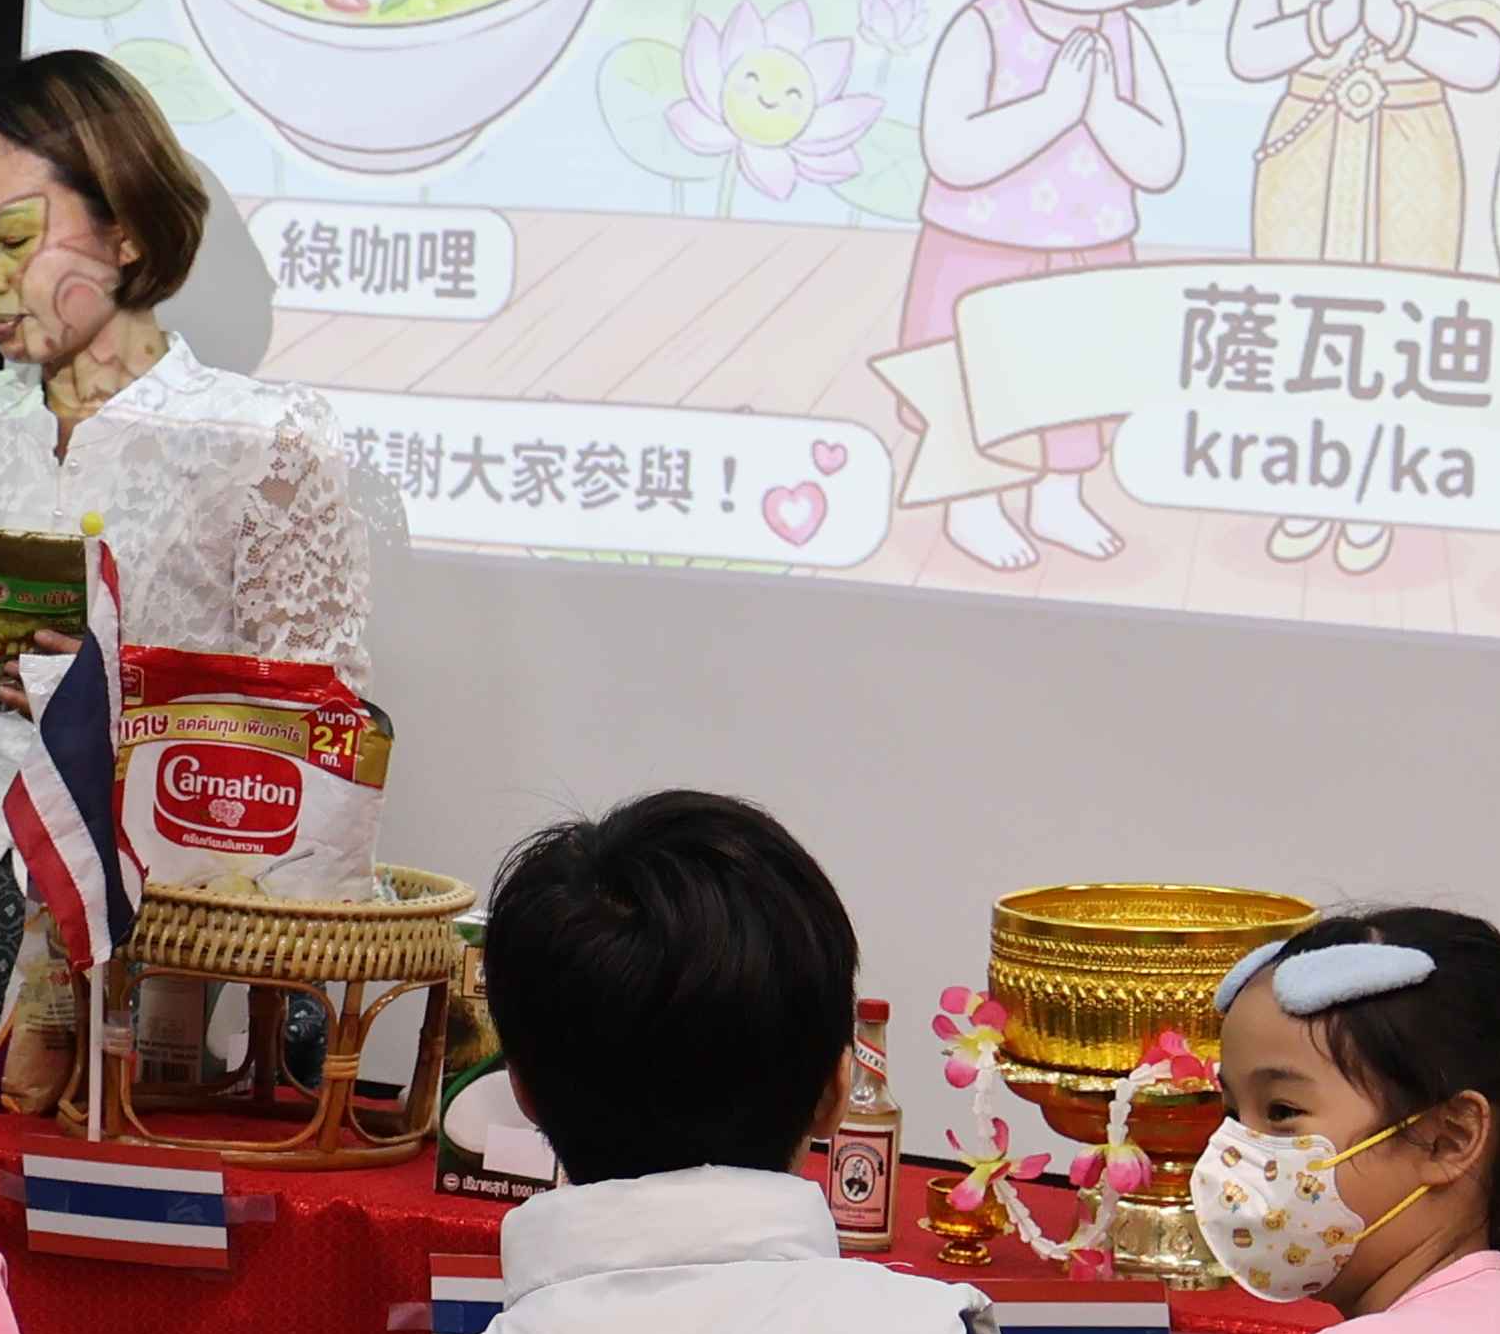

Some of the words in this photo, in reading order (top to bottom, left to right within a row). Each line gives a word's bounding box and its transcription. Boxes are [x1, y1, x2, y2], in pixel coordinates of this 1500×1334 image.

[278, 219, 477, 299] 綠咖哩
[1178, 282, 1494, 408] 薩瓦迪
[1182, 411, 1477, 500] krab/ka
[120, 714, 169, 741] เศษ
[312, 725, 355, 757] 2.1
[315, 709, 357, 727] ขนาด
[163, 755, 296, 806] Carnation
